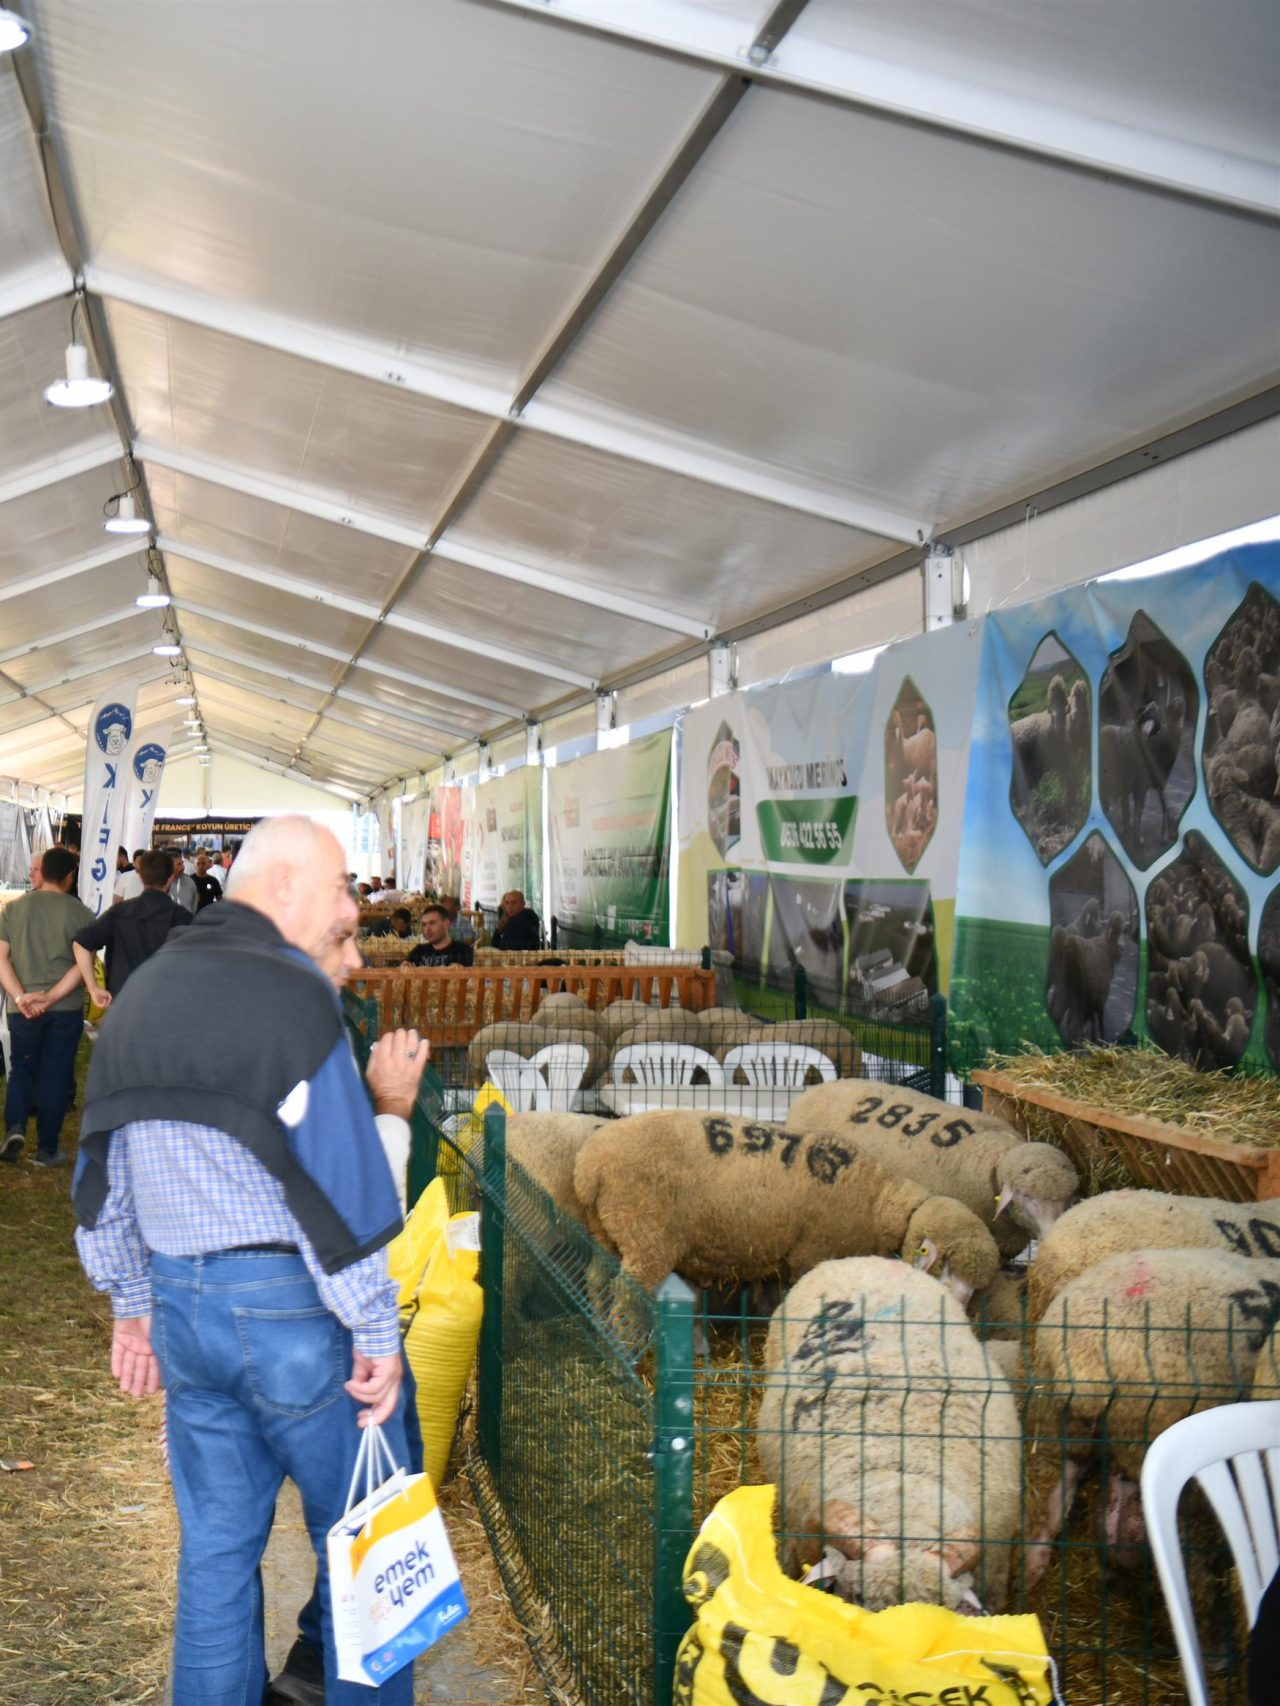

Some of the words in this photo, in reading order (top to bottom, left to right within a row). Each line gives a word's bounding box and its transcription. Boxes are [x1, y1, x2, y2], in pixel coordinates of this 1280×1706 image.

[195, 822, 223, 831] KOYUN
[374, 1539, 430, 1595] emek
[389, 1561, 435, 1608] yem
